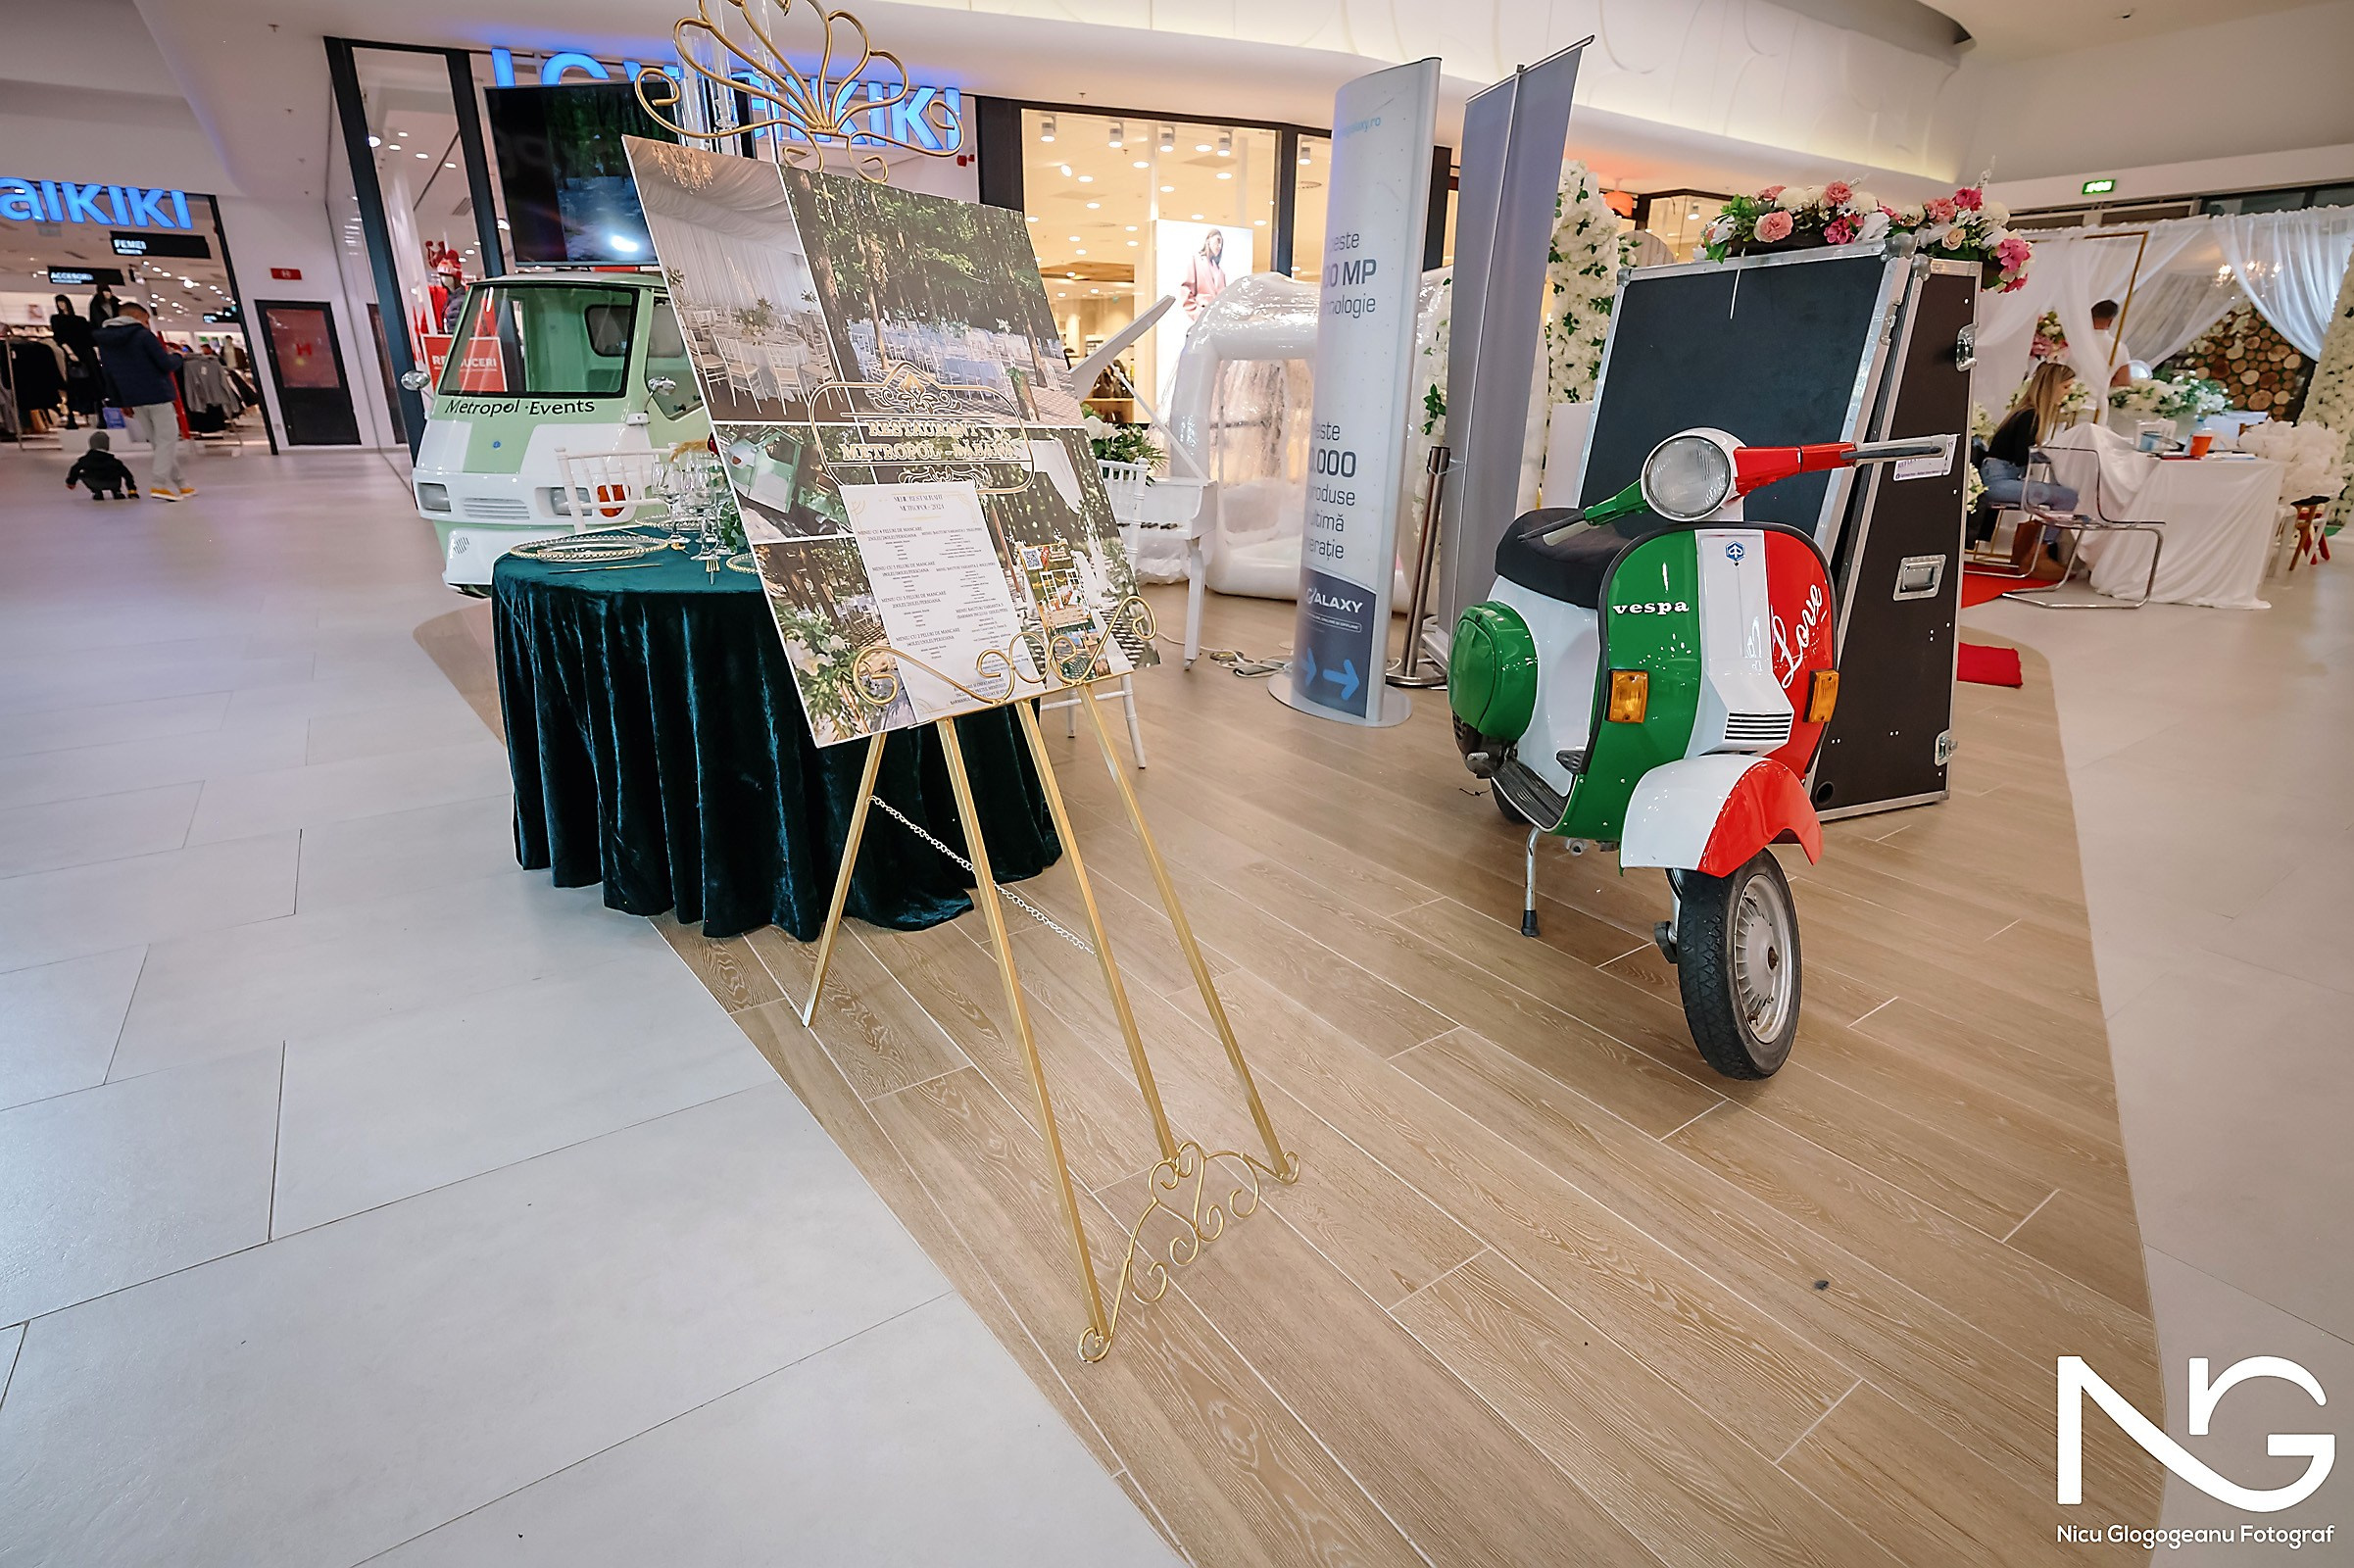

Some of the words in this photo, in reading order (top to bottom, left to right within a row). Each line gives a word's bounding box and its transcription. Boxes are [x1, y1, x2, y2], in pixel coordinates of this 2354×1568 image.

[1343, 259, 1377, 286] MP
[445, 399, 520, 416] Metropol
[866, 420, 979, 437] RESTAURANT
[838, 441, 942, 462] METROPOL
[1612, 601, 1690, 615] vespa
[1771, 584, 1824, 689] Love
